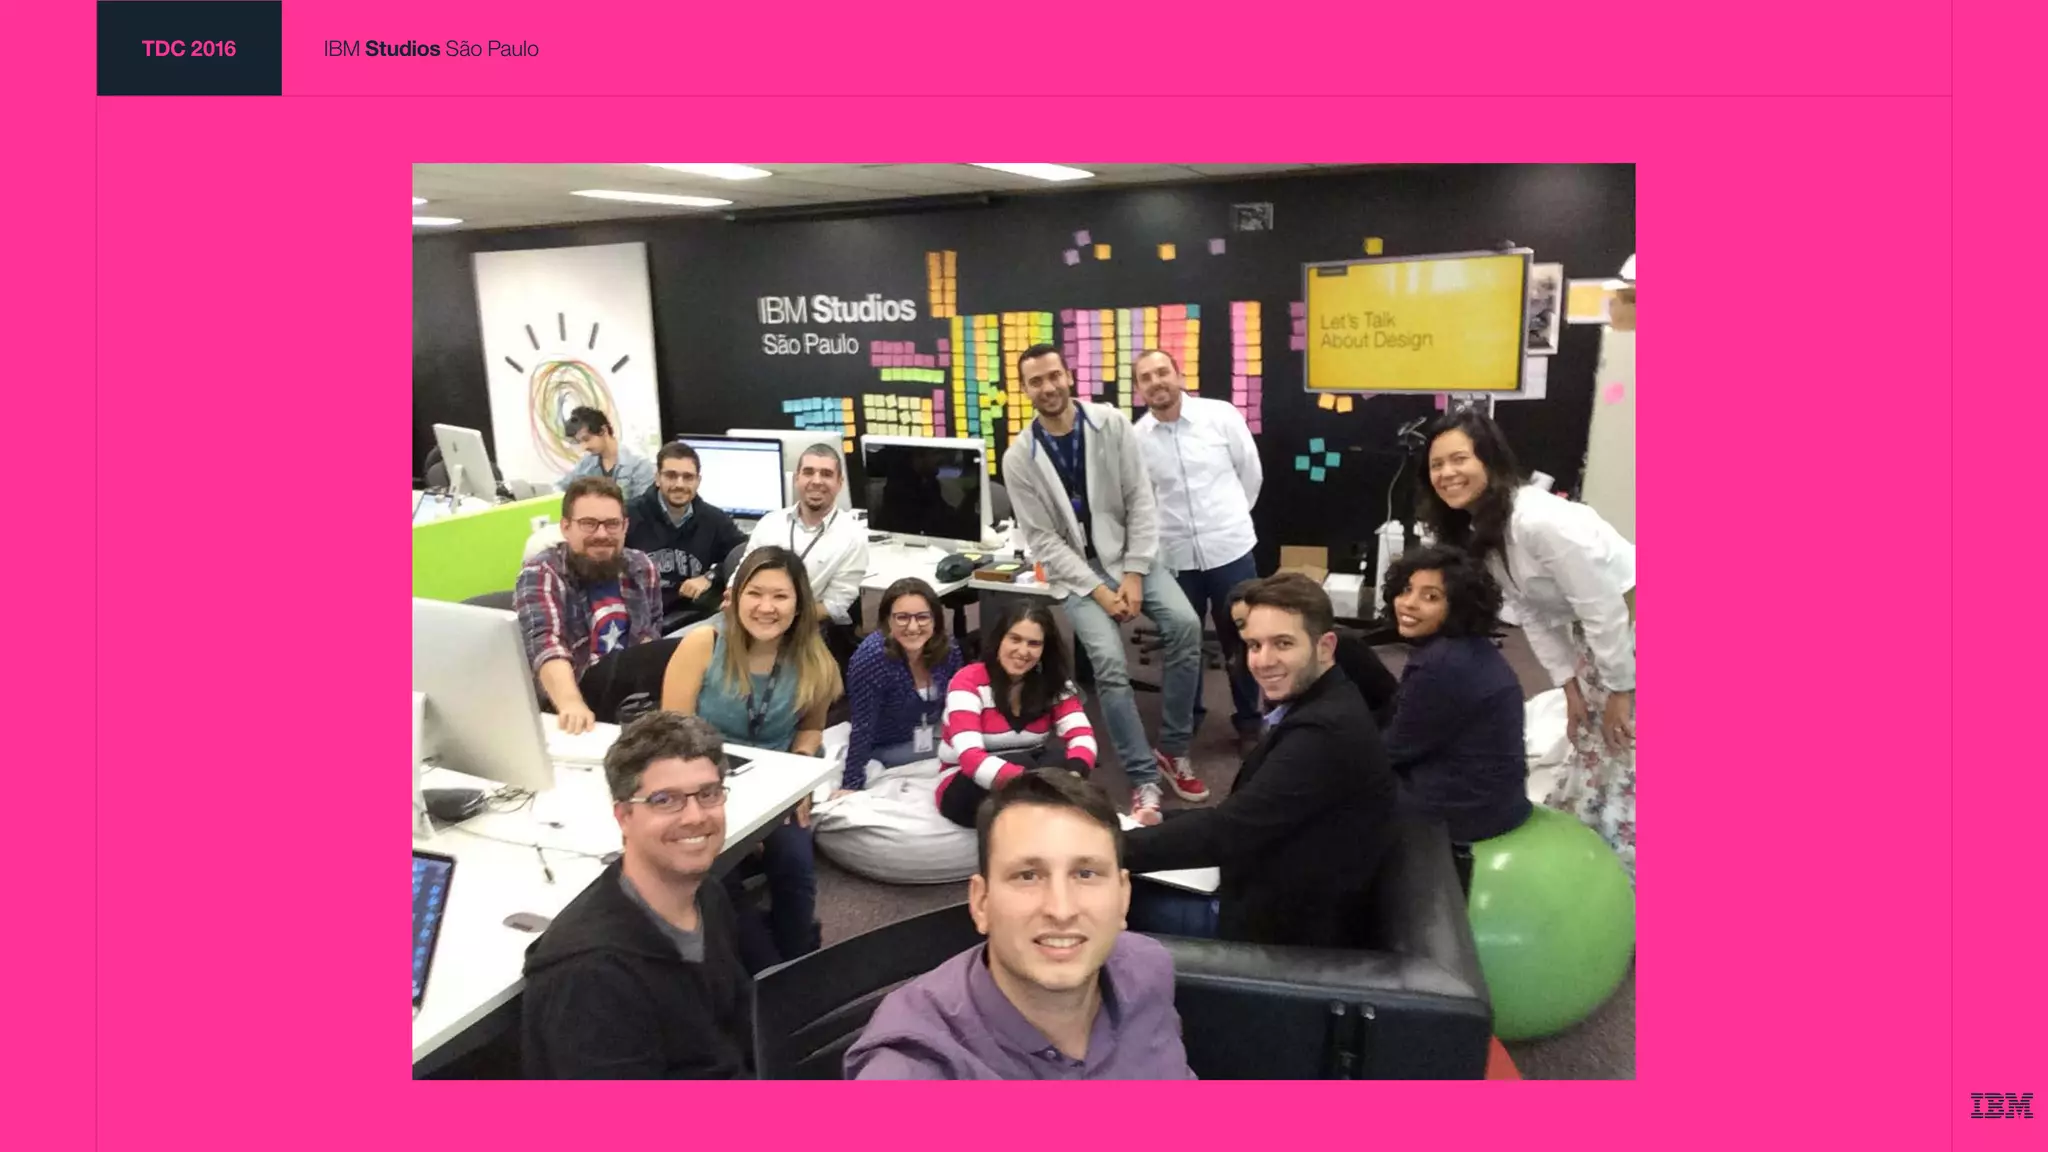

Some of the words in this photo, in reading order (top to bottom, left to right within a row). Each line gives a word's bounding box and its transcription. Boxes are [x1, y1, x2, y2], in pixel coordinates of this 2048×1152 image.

[758, 296, 808, 324] IBM
[811, 293, 917, 323] Studios
[1320, 314, 1359, 330] Let's
[1364, 311, 1396, 328] Talk
[762, 333, 801, 355] São
[803, 333, 860, 355] Paulo
[1320, 331, 1369, 348] About
[1374, 331, 1434, 351] Design
